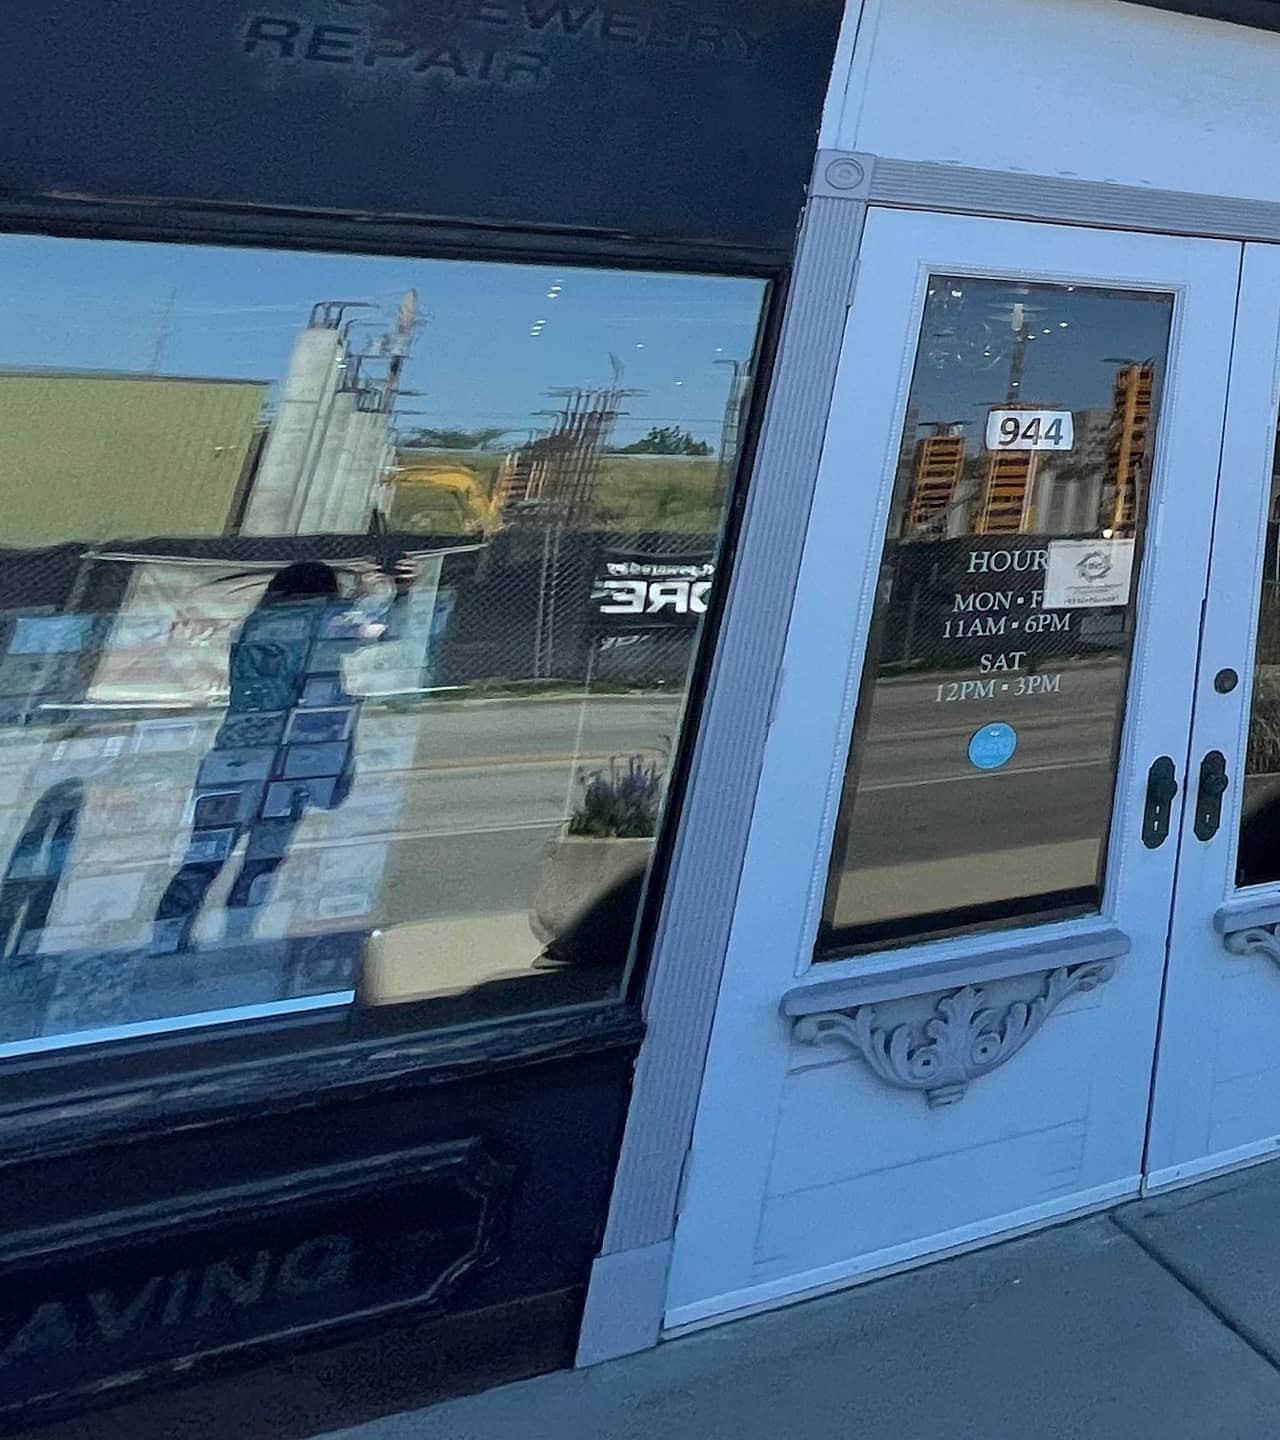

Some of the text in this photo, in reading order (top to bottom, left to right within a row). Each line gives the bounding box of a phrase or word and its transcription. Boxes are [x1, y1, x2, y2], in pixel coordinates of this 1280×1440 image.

[243, 15, 551, 85] REPAIR
[998, 417, 1064, 446] 944
[966, 549, 1049, 574] HOUR
[952, 590, 1014, 613] MON
[943, 612, 1071, 639] 11AM 6PM
[979, 651, 1027, 674] SAT
[935, 673, 1062, 703] 12PM 3PM
